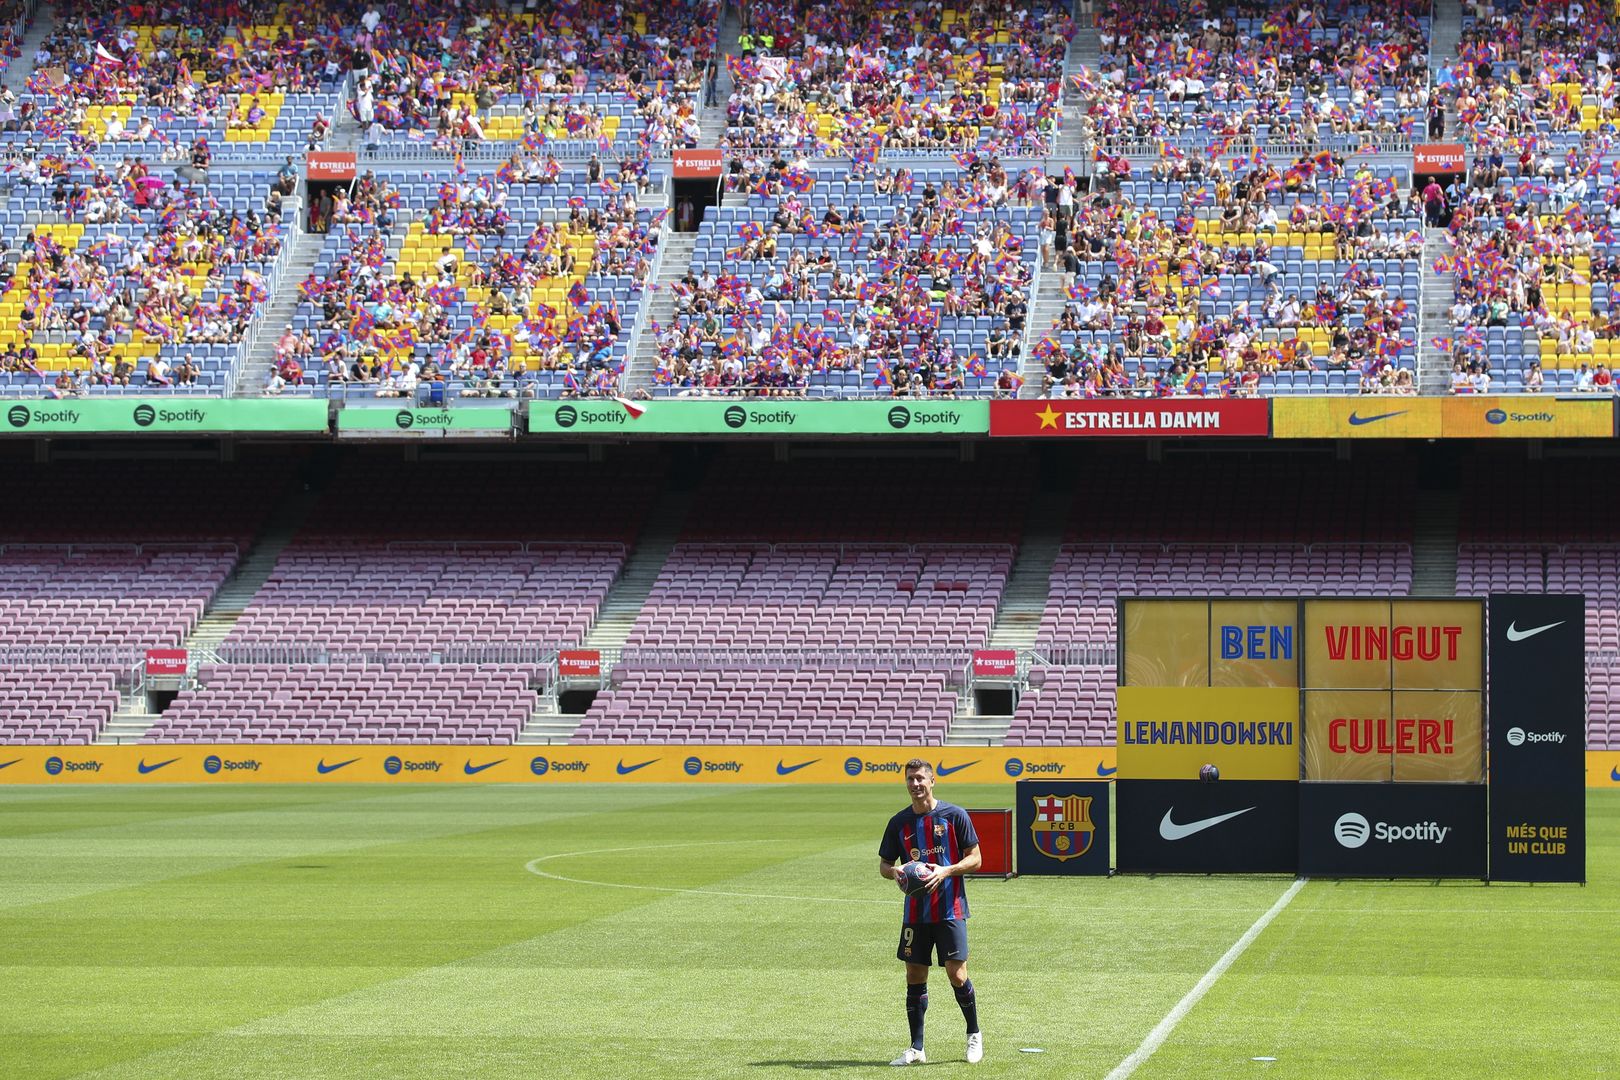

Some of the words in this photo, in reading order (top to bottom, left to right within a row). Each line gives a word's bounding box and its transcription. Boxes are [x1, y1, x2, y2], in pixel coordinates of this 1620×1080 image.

[685, 159, 722, 167] ESTRELLA
[1426, 154, 1464, 163] ESTRELLA
[319, 162, 356, 170] ESTRELLA
[33, 410, 80, 424] Spotify
[159, 409, 206, 423] Spotify
[416, 414, 454, 425] Spotify
[581, 410, 627, 424] Spotify
[750, 410, 796, 424] Spotify
[914, 411, 960, 425] Spotify
[1065, 411, 1156, 429] ESTRELLA
[1160, 411, 1220, 428] DAMM
[1510, 412, 1555, 423] Spotify
[1220, 625, 1293, 660] BEN
[1325, 625, 1463, 661] VINGUT
[1124, 721, 1293, 746] LEWANDOWSKI
[1328, 718, 1454, 755] CULER!
[1527, 731, 1565, 744] Spotify
[65, 760, 102, 772] Spotify
[223, 759, 260, 772] Spotify
[404, 760, 441, 772] Spotify
[551, 760, 588, 773] Spotify
[704, 760, 741, 773] Spotify
[864, 761, 903, 773] Spotify
[1025, 762, 1063, 774] Spotify
[1374, 821, 1448, 844] Spotify
[1506, 822, 1536, 839] MÉS
[1540, 826, 1567, 839] QUE
[921, 845, 946, 857] Spotify
[1508, 842, 1529, 855] UN
[1531, 842, 1566, 855] CLUB
[904, 927, 914, 947] 9
